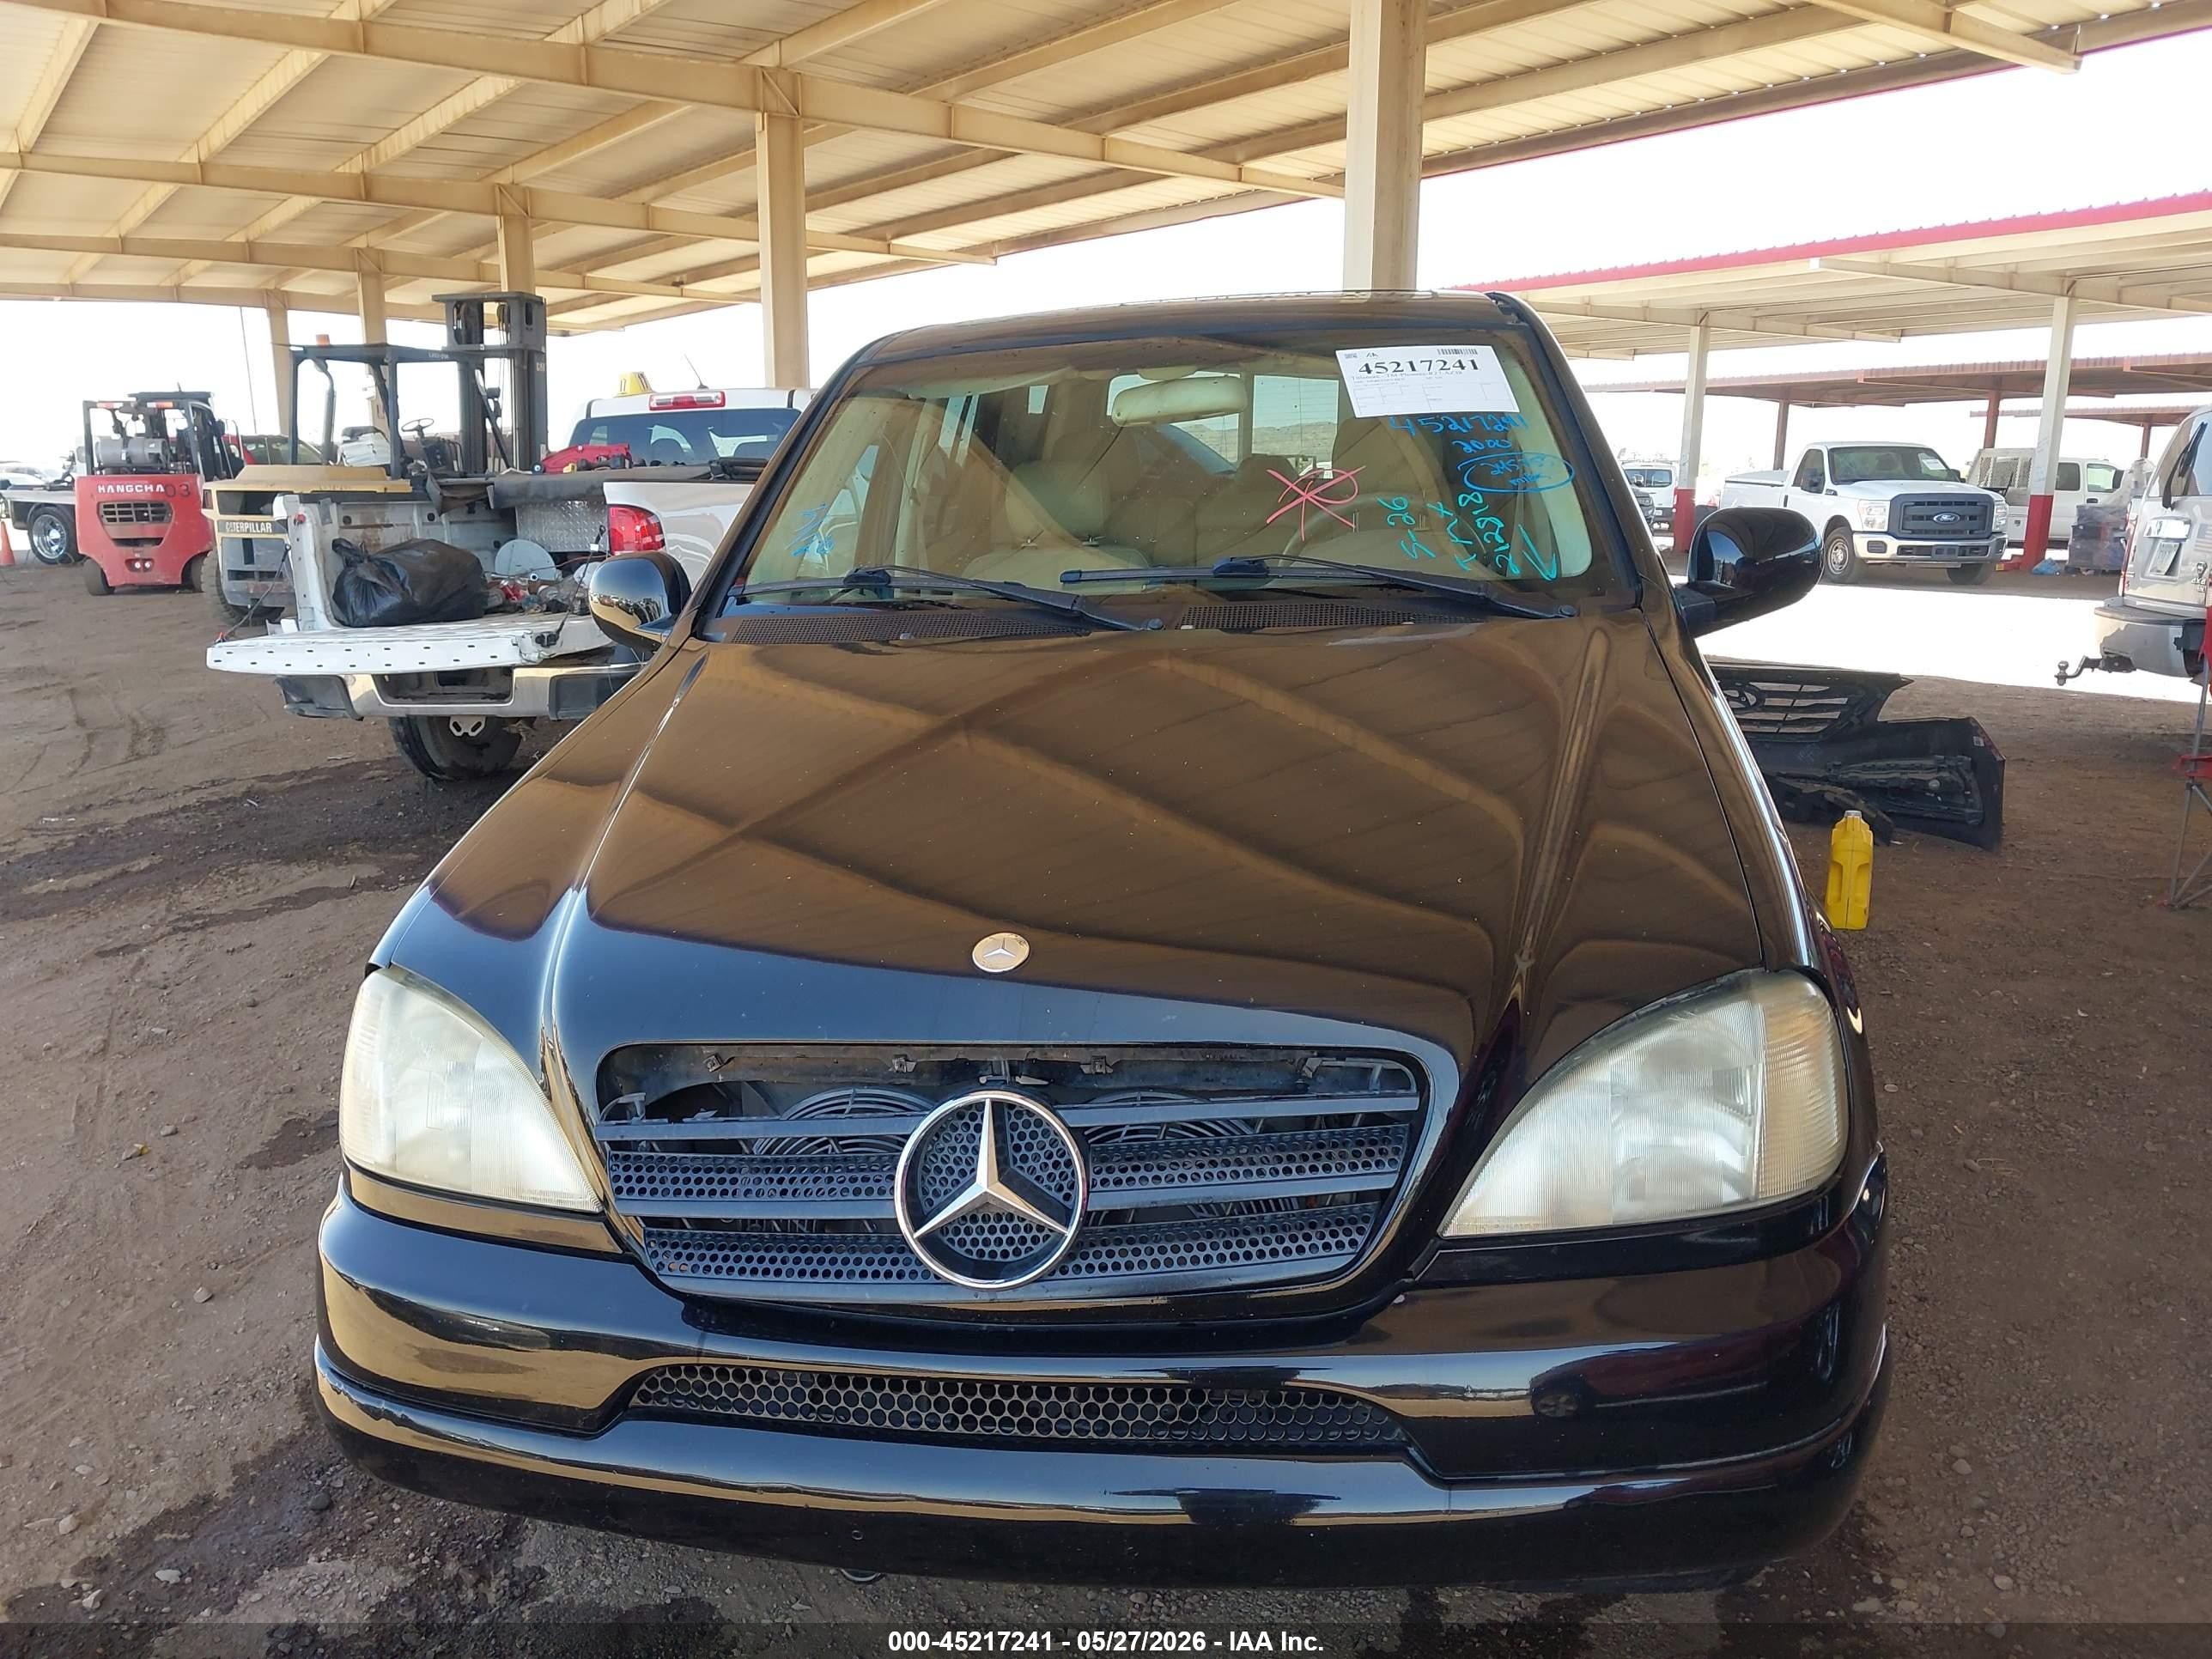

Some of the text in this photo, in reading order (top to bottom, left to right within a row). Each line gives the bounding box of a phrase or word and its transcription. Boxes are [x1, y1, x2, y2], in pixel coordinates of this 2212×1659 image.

[1358, 359, 1479, 374] 45217241
[97, 483, 165, 494] HANGCHA
[226, 521, 272, 533] CATERPILLAR
